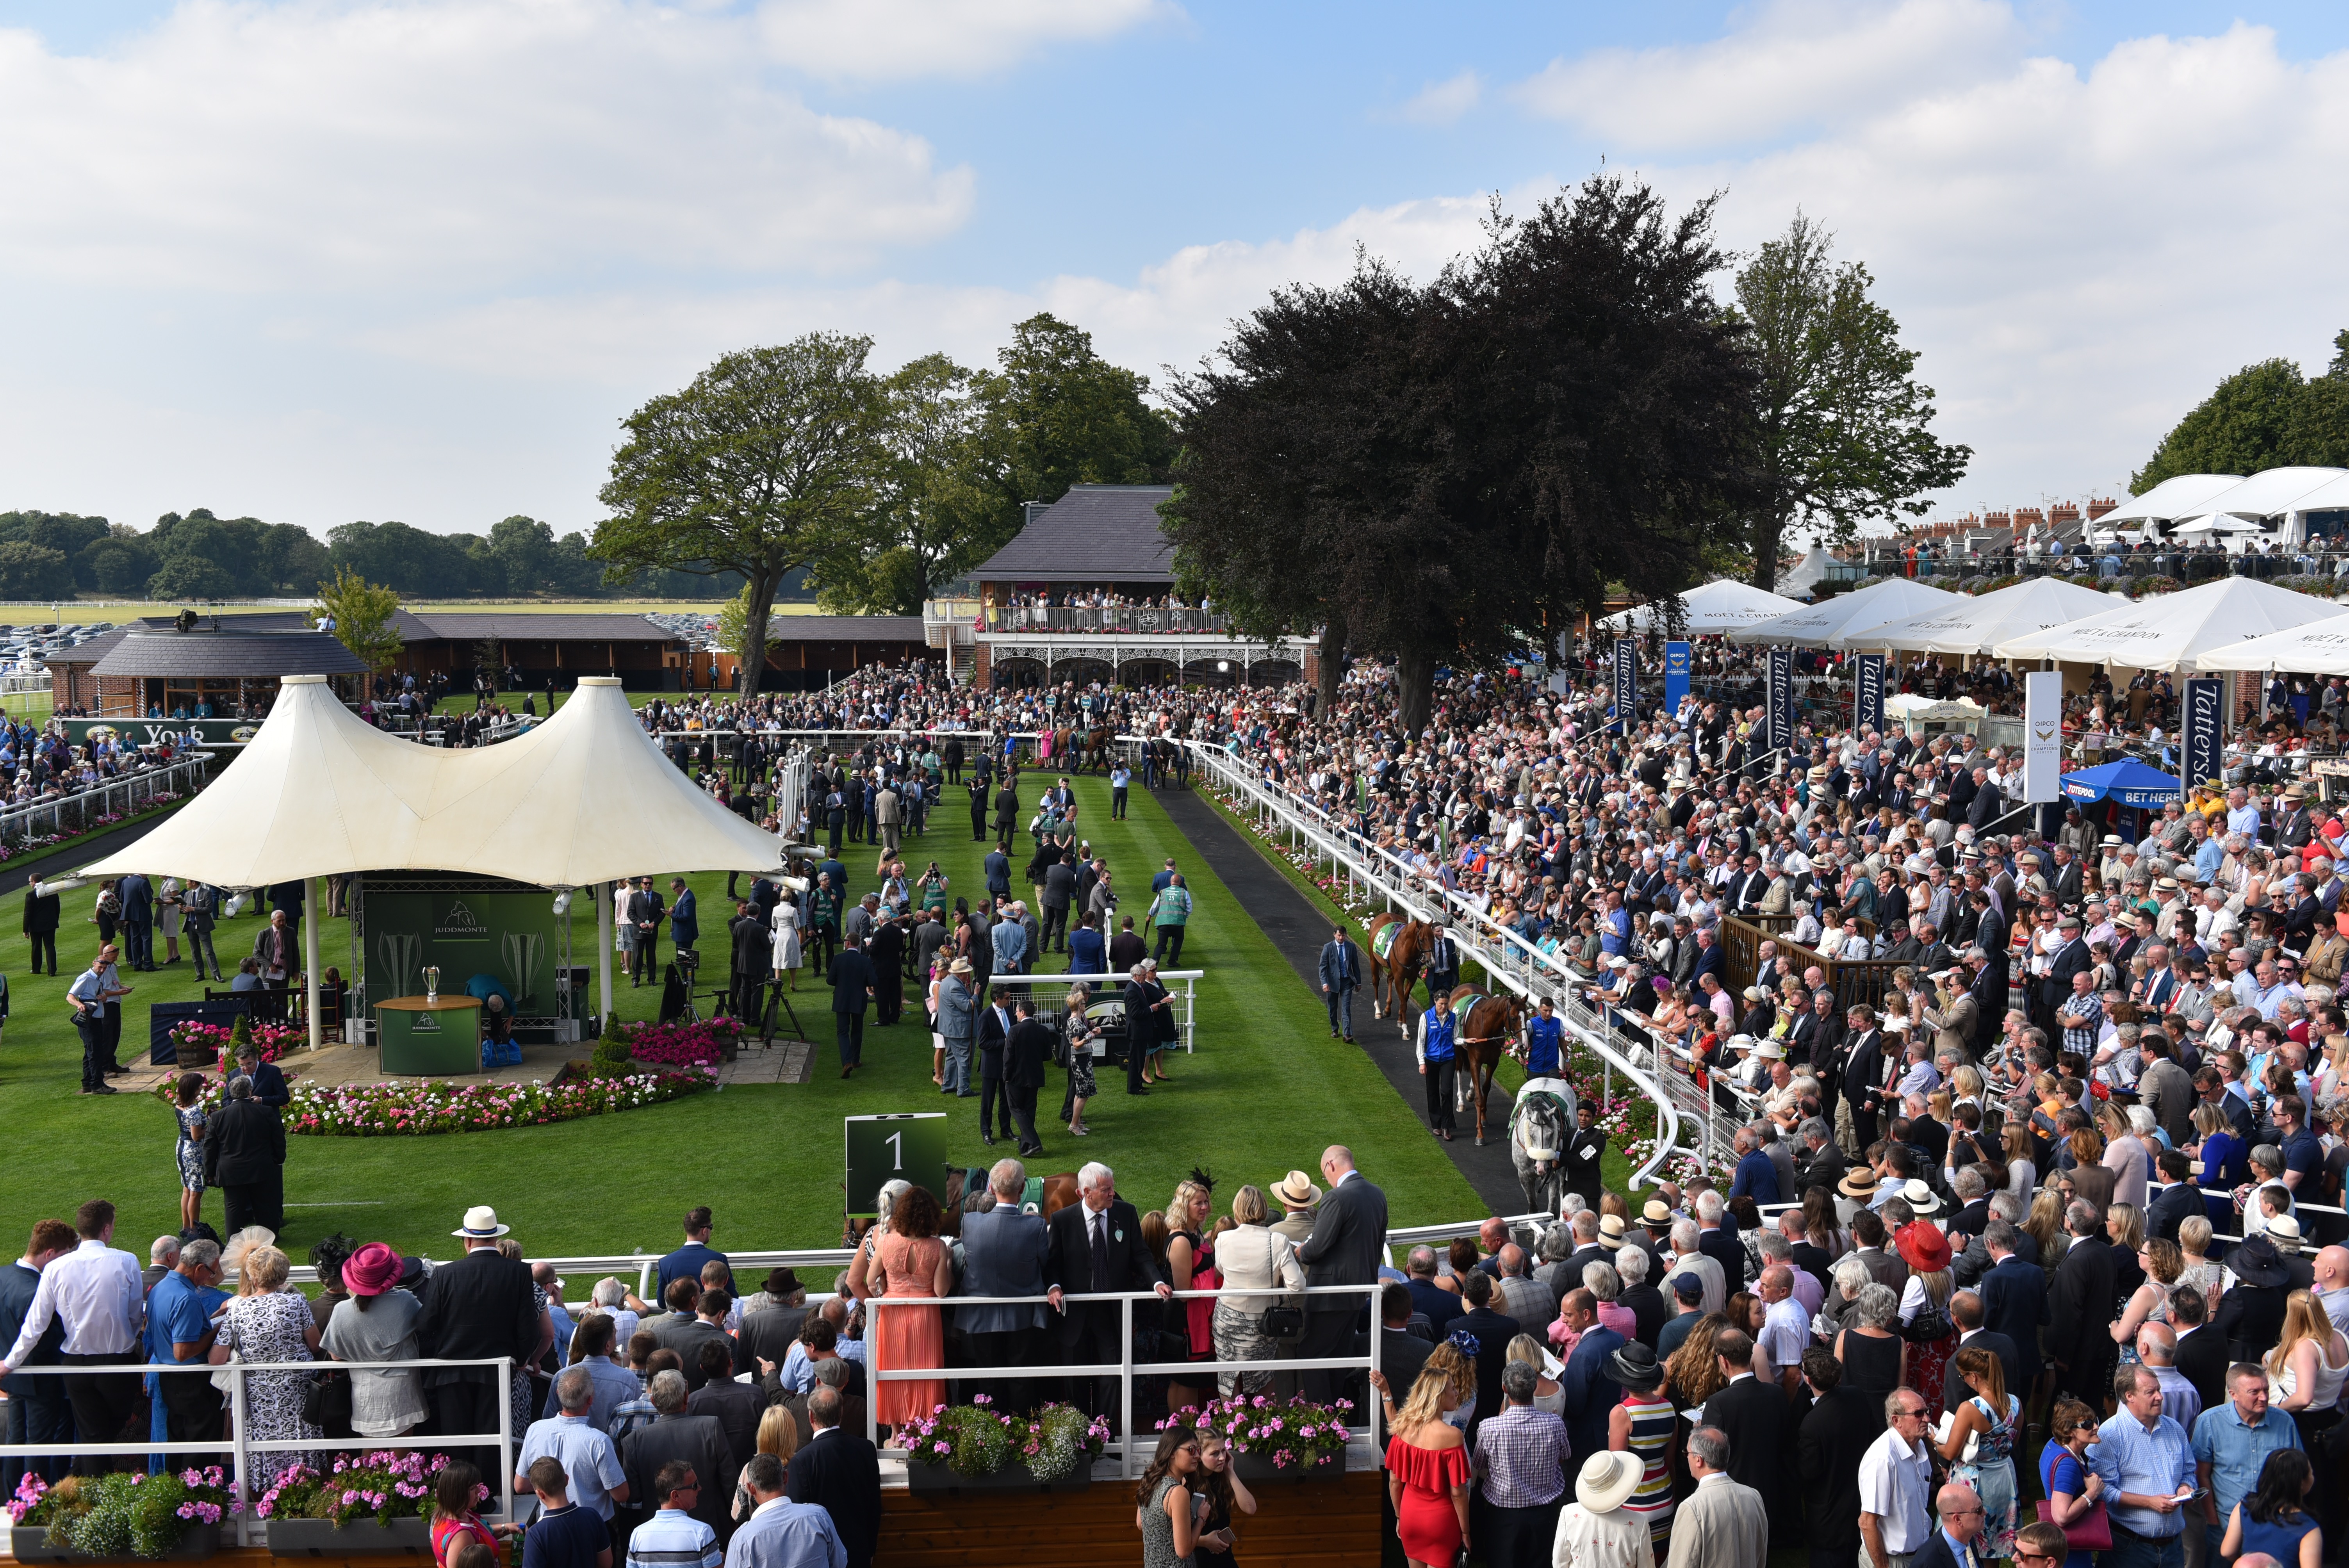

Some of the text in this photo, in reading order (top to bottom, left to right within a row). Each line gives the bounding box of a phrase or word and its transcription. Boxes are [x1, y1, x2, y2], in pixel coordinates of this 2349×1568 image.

[2107, 631, 2164, 640] CHANDON
[2296, 634, 2343, 642] MOËT
[1620, 642, 1633, 715] Tattersalls
[1862, 658, 1880, 723] Tatters
[1775, 654, 1789, 744] Tattersalls
[1934, 704, 1960, 712] Charlotte's
[144, 725, 204, 744] Yok
[2193, 685, 2217, 787] Tattersa
[2320, 766, 2338, 774] Seriously
[1356, 780, 1360, 796] 3
[2068, 784, 2096, 798] TOTEPOOL
[2126, 792, 2180, 803] BET HERE
[1375, 931, 1385, 945] 13
[885, 1130, 903, 1171] 1
